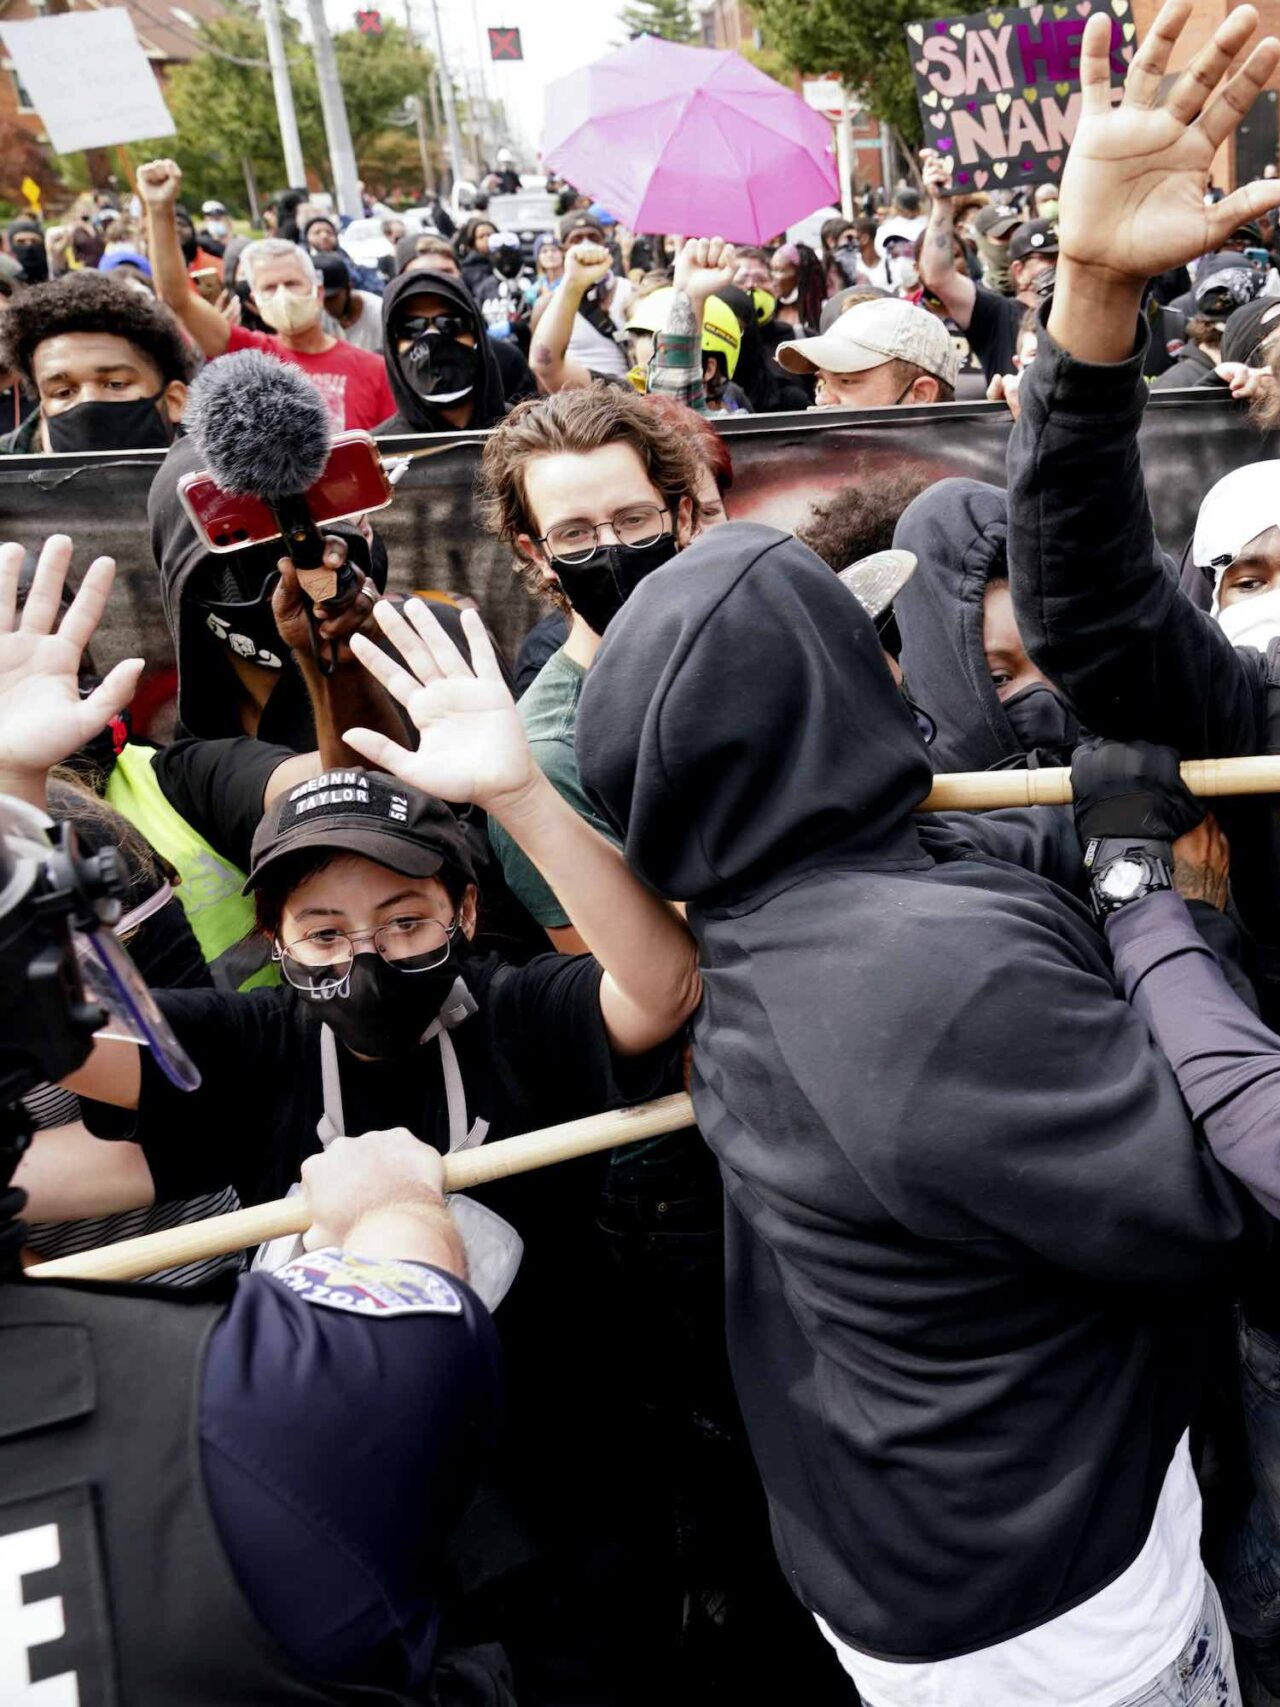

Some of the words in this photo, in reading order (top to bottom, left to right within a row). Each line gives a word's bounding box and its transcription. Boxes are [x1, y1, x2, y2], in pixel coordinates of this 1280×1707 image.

[923, 25, 1014, 97] SAY
[289, 772, 369, 801] BREONNA
[295, 788, 370, 815] TAYLOR
[390, 795, 408, 821] 502
[308, 975, 351, 1000] LOU
